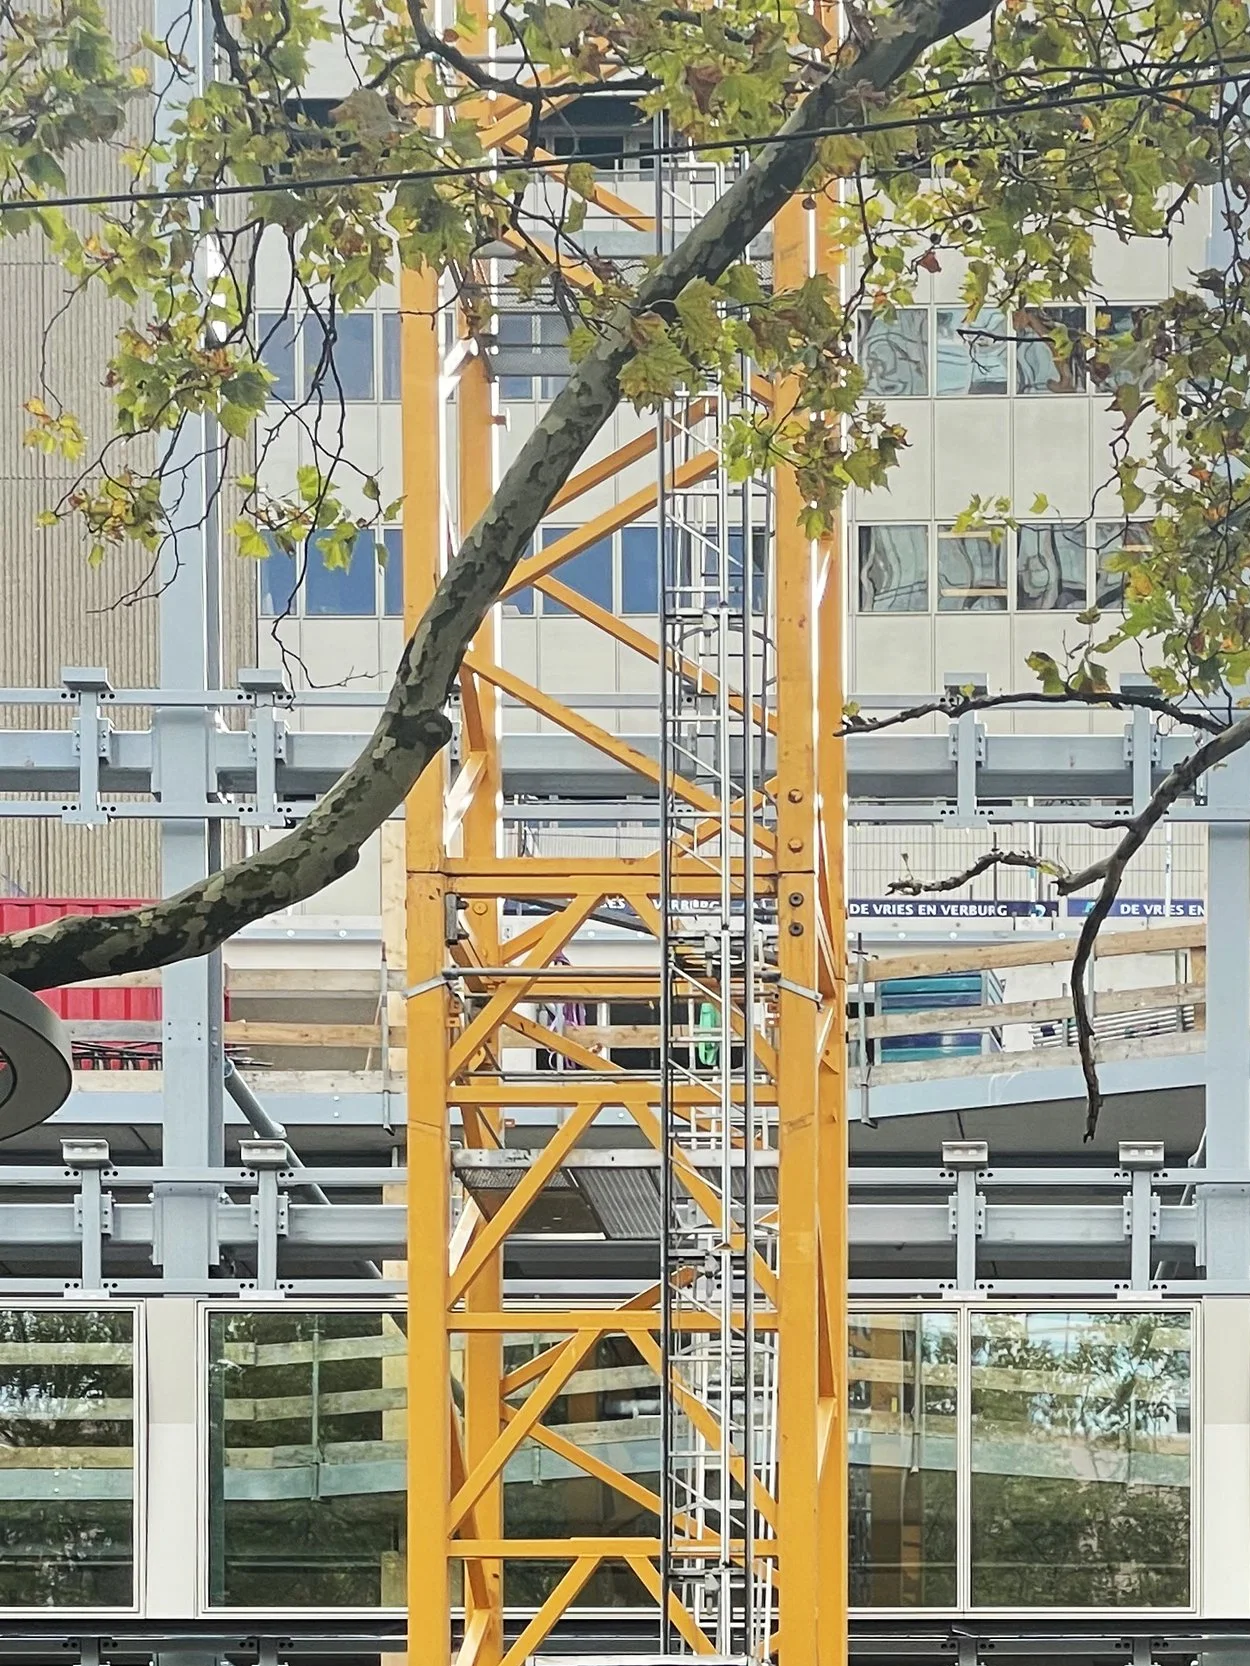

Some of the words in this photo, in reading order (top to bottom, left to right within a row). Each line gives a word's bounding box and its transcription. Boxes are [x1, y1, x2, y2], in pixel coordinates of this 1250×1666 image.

[849, 904, 869, 915] DE
[873, 904, 913, 915] VRIES
[918, 905, 937, 915] EN
[940, 904, 1008, 916] VERBURG
[1120, 904, 1139, 915] DE
